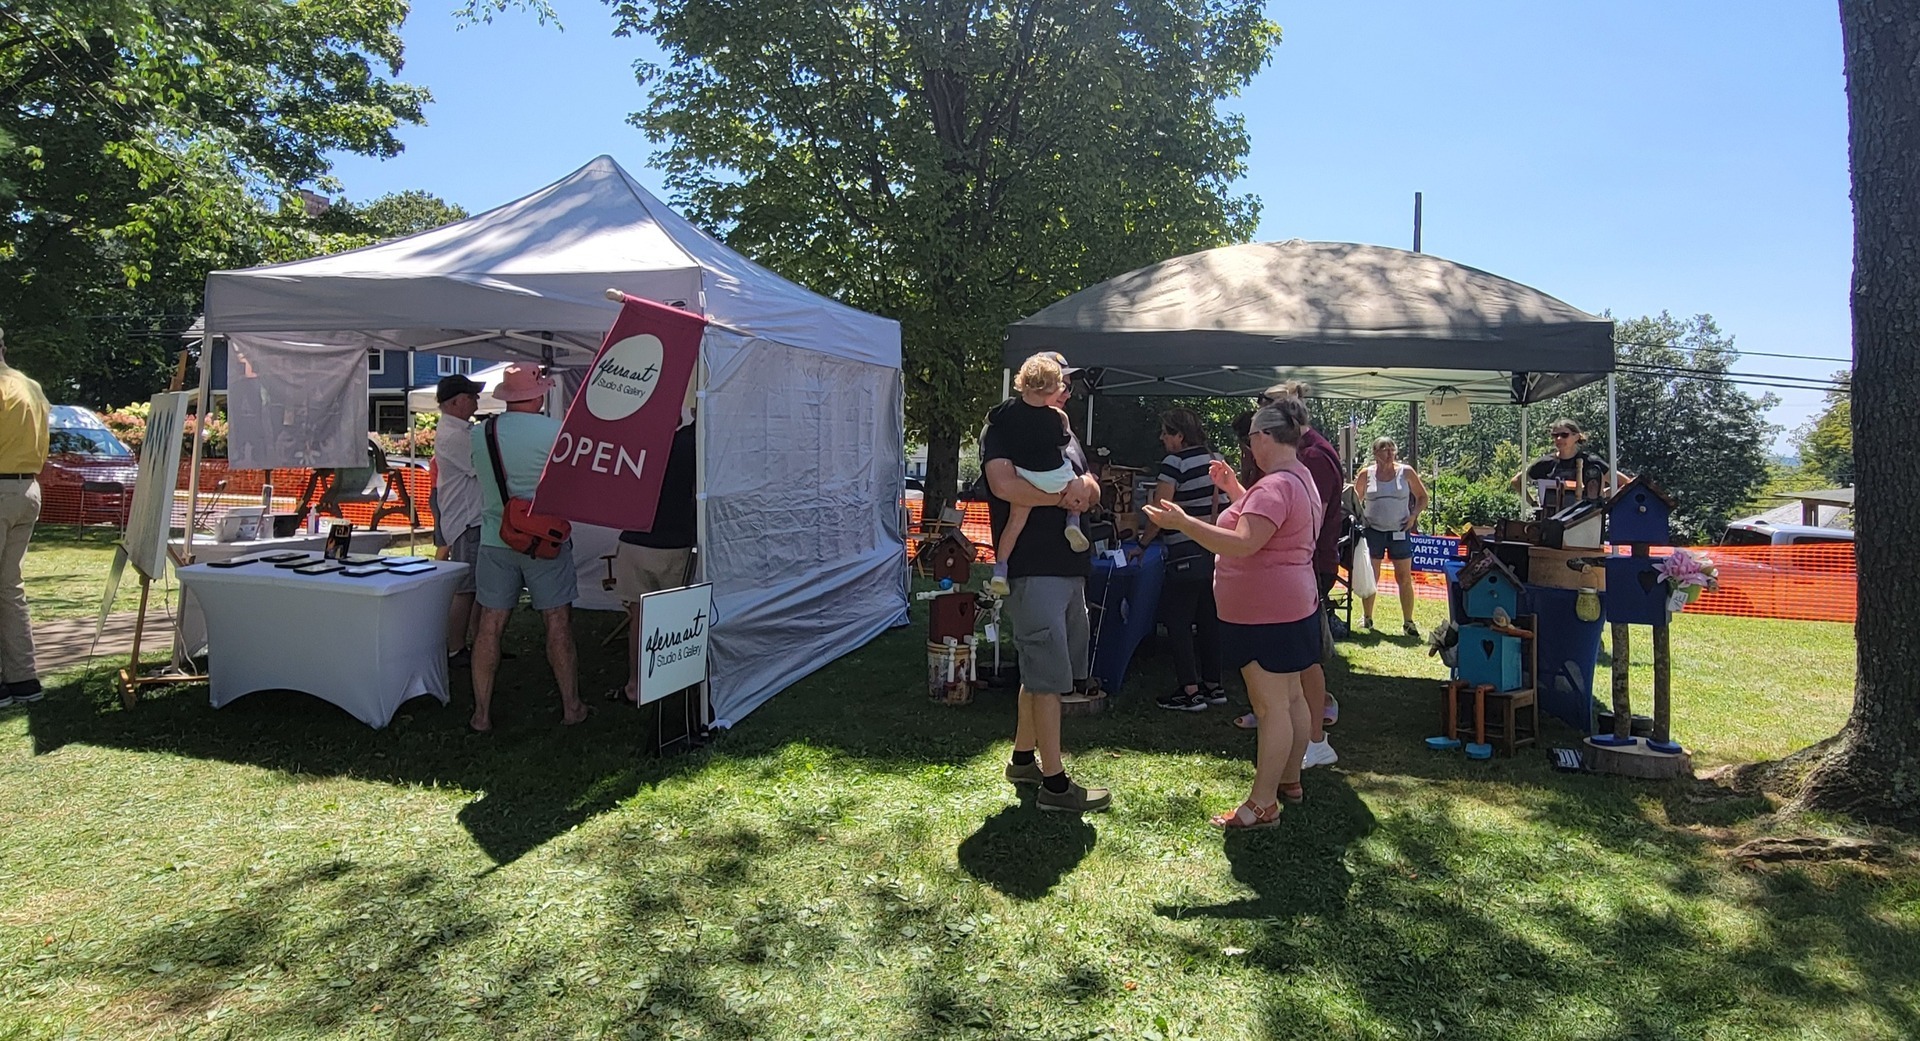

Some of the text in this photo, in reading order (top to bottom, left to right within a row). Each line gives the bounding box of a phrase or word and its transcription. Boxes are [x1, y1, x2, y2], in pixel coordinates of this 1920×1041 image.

[597, 377, 646, 399] Studio & Gallery
[551, 432, 647, 481] OPEN
[1414, 545, 1450, 556] ARTS &
[656, 644, 702, 667] Studio & Gallery
